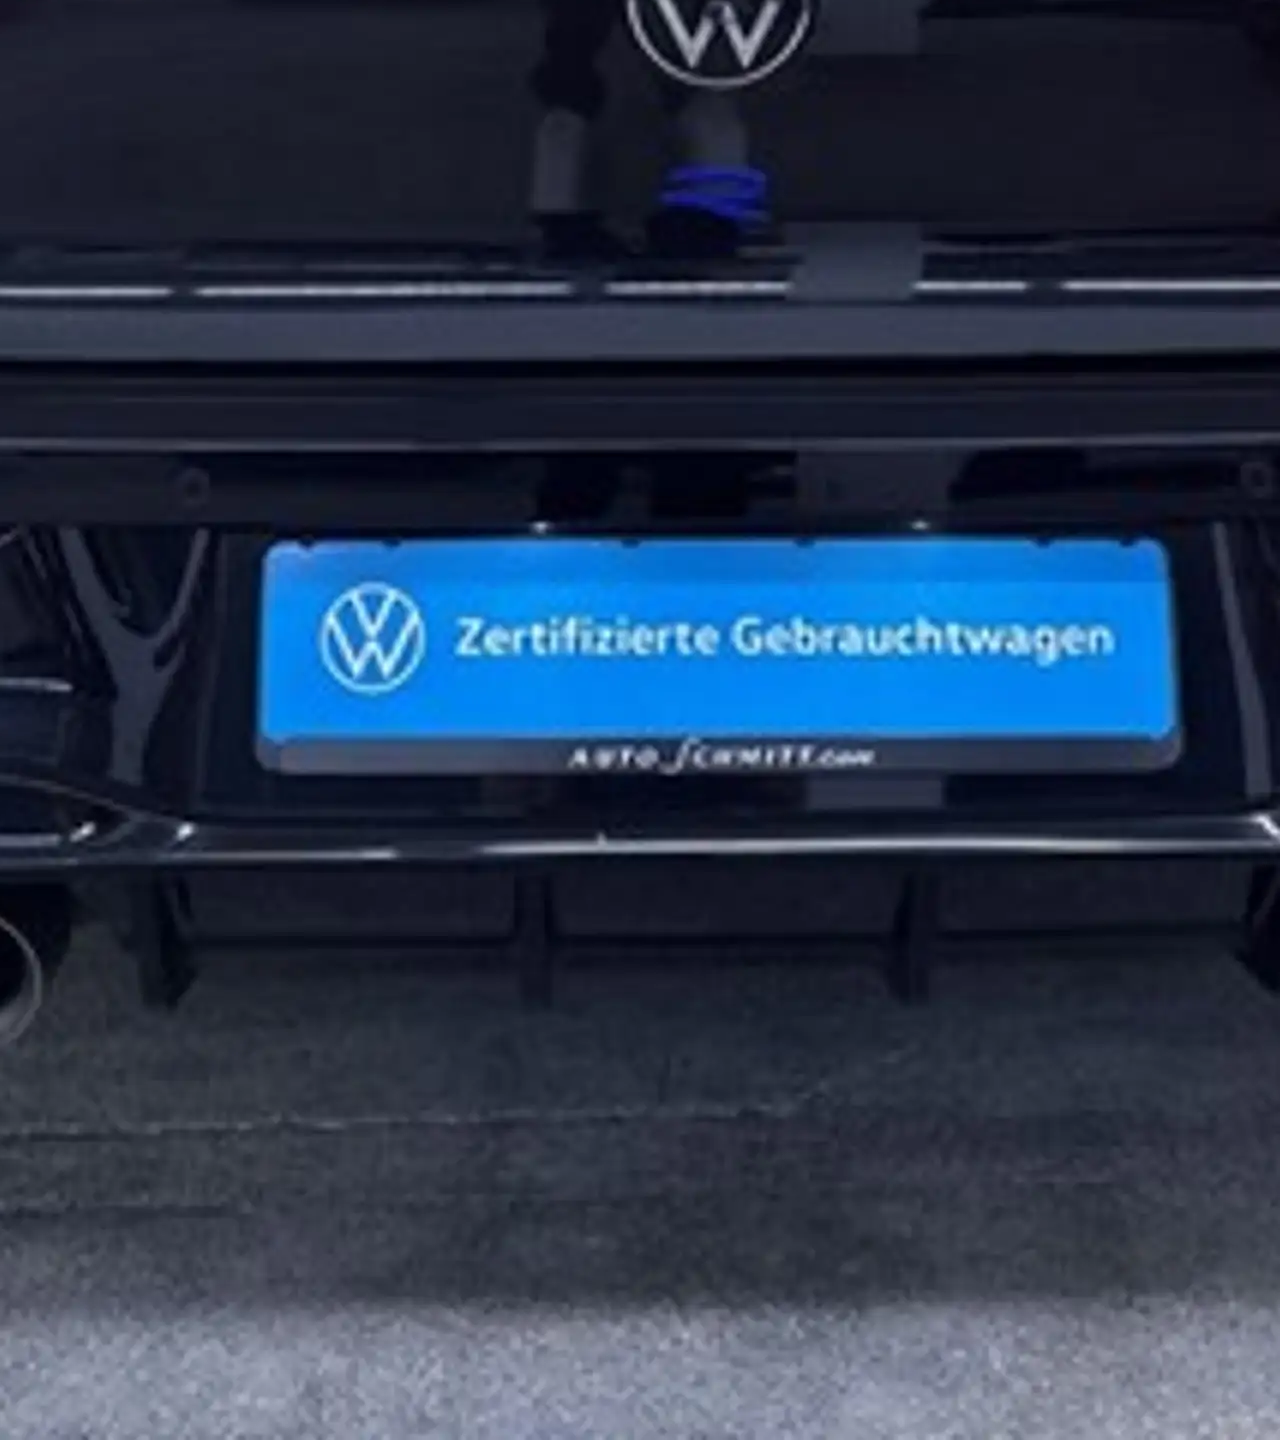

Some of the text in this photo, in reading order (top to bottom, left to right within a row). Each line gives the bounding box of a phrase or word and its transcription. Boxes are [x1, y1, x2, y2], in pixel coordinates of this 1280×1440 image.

[455, 615, 1115, 666] Zertifizierte Gebrauchtwagen
[569, 744, 660, 769] AUTO
